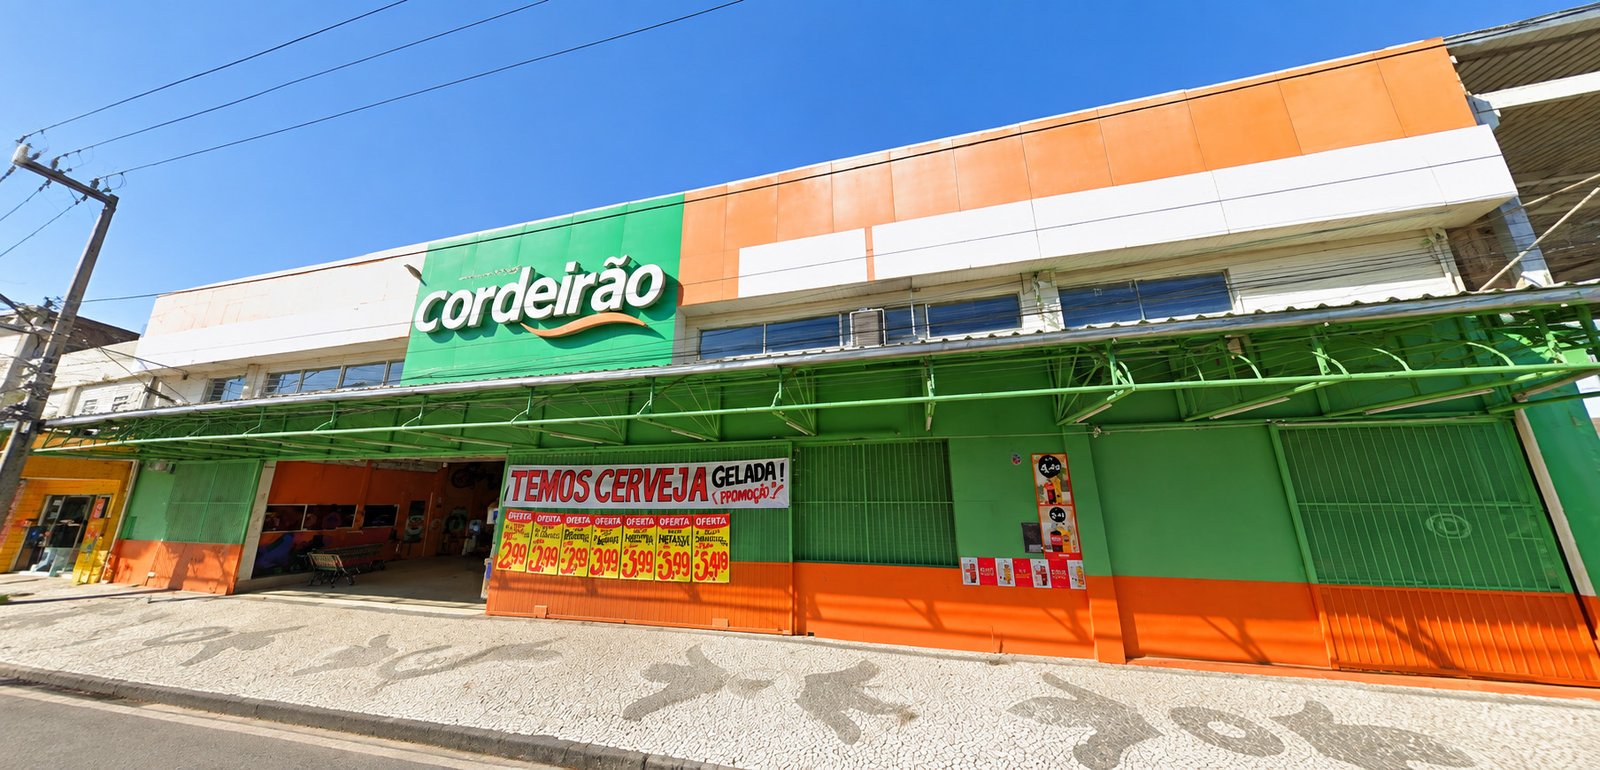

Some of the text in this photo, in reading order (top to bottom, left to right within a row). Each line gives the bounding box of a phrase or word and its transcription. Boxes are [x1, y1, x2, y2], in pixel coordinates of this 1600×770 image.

[511, 469, 593, 503] TEMOS
[594, 466, 709, 503] CERVEJA
[659, 517, 690, 526] OFERTA
[695, 516, 727, 526] OFERTA
